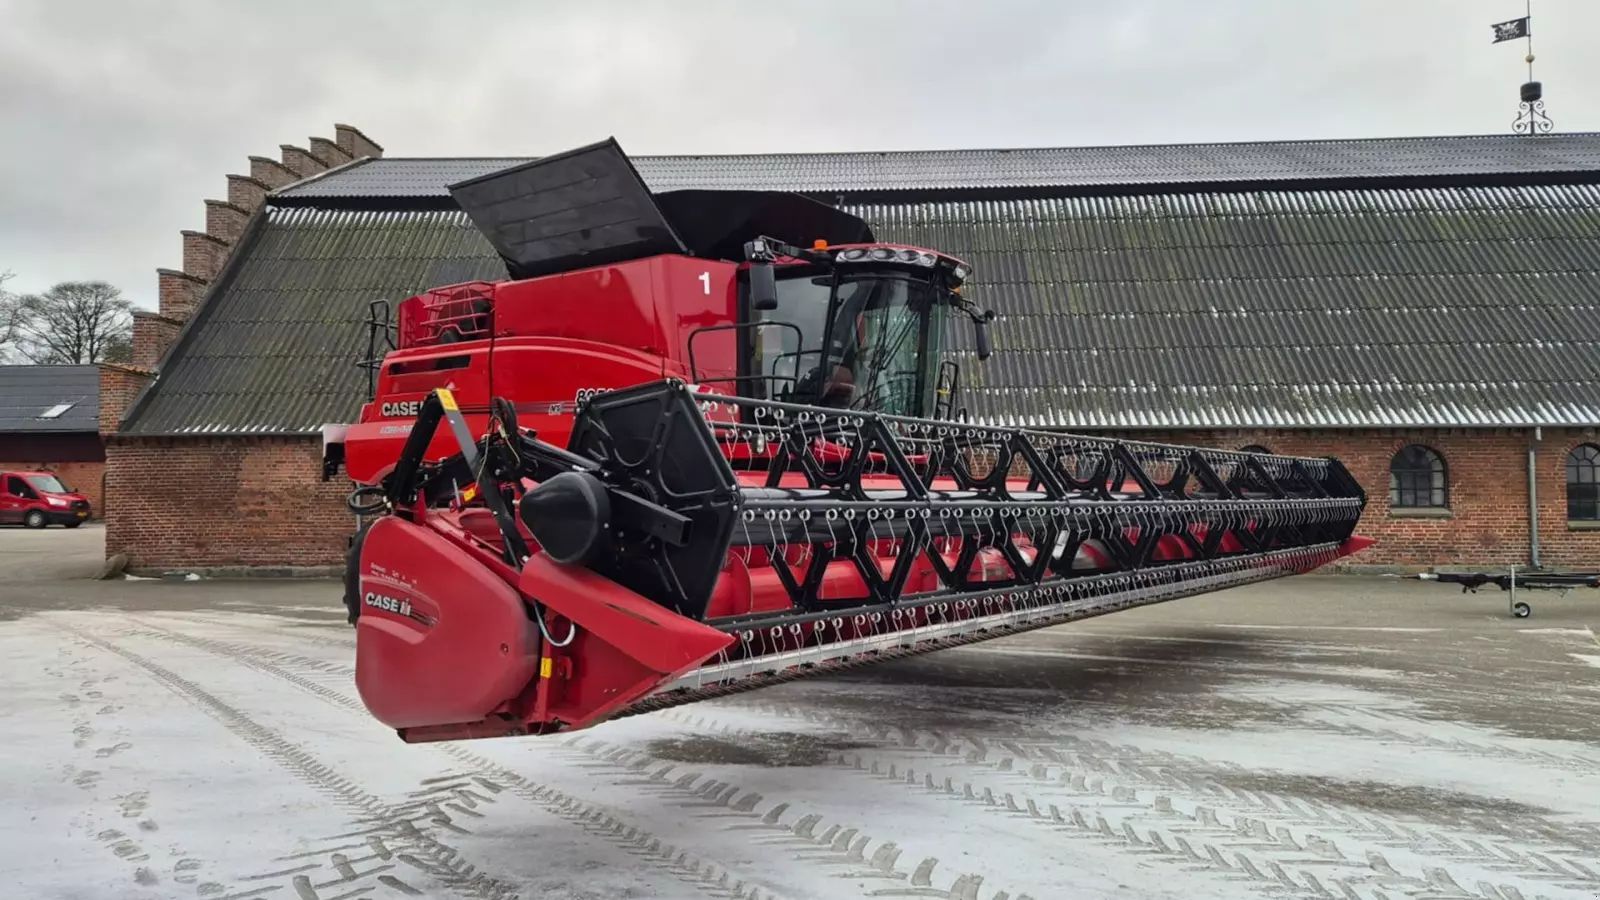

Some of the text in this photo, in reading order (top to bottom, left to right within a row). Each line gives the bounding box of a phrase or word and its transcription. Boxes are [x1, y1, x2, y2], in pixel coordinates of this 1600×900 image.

[698, 271, 710, 295] 1
[382, 401, 418, 417] CASE
[365, 592, 399, 613] CASE
